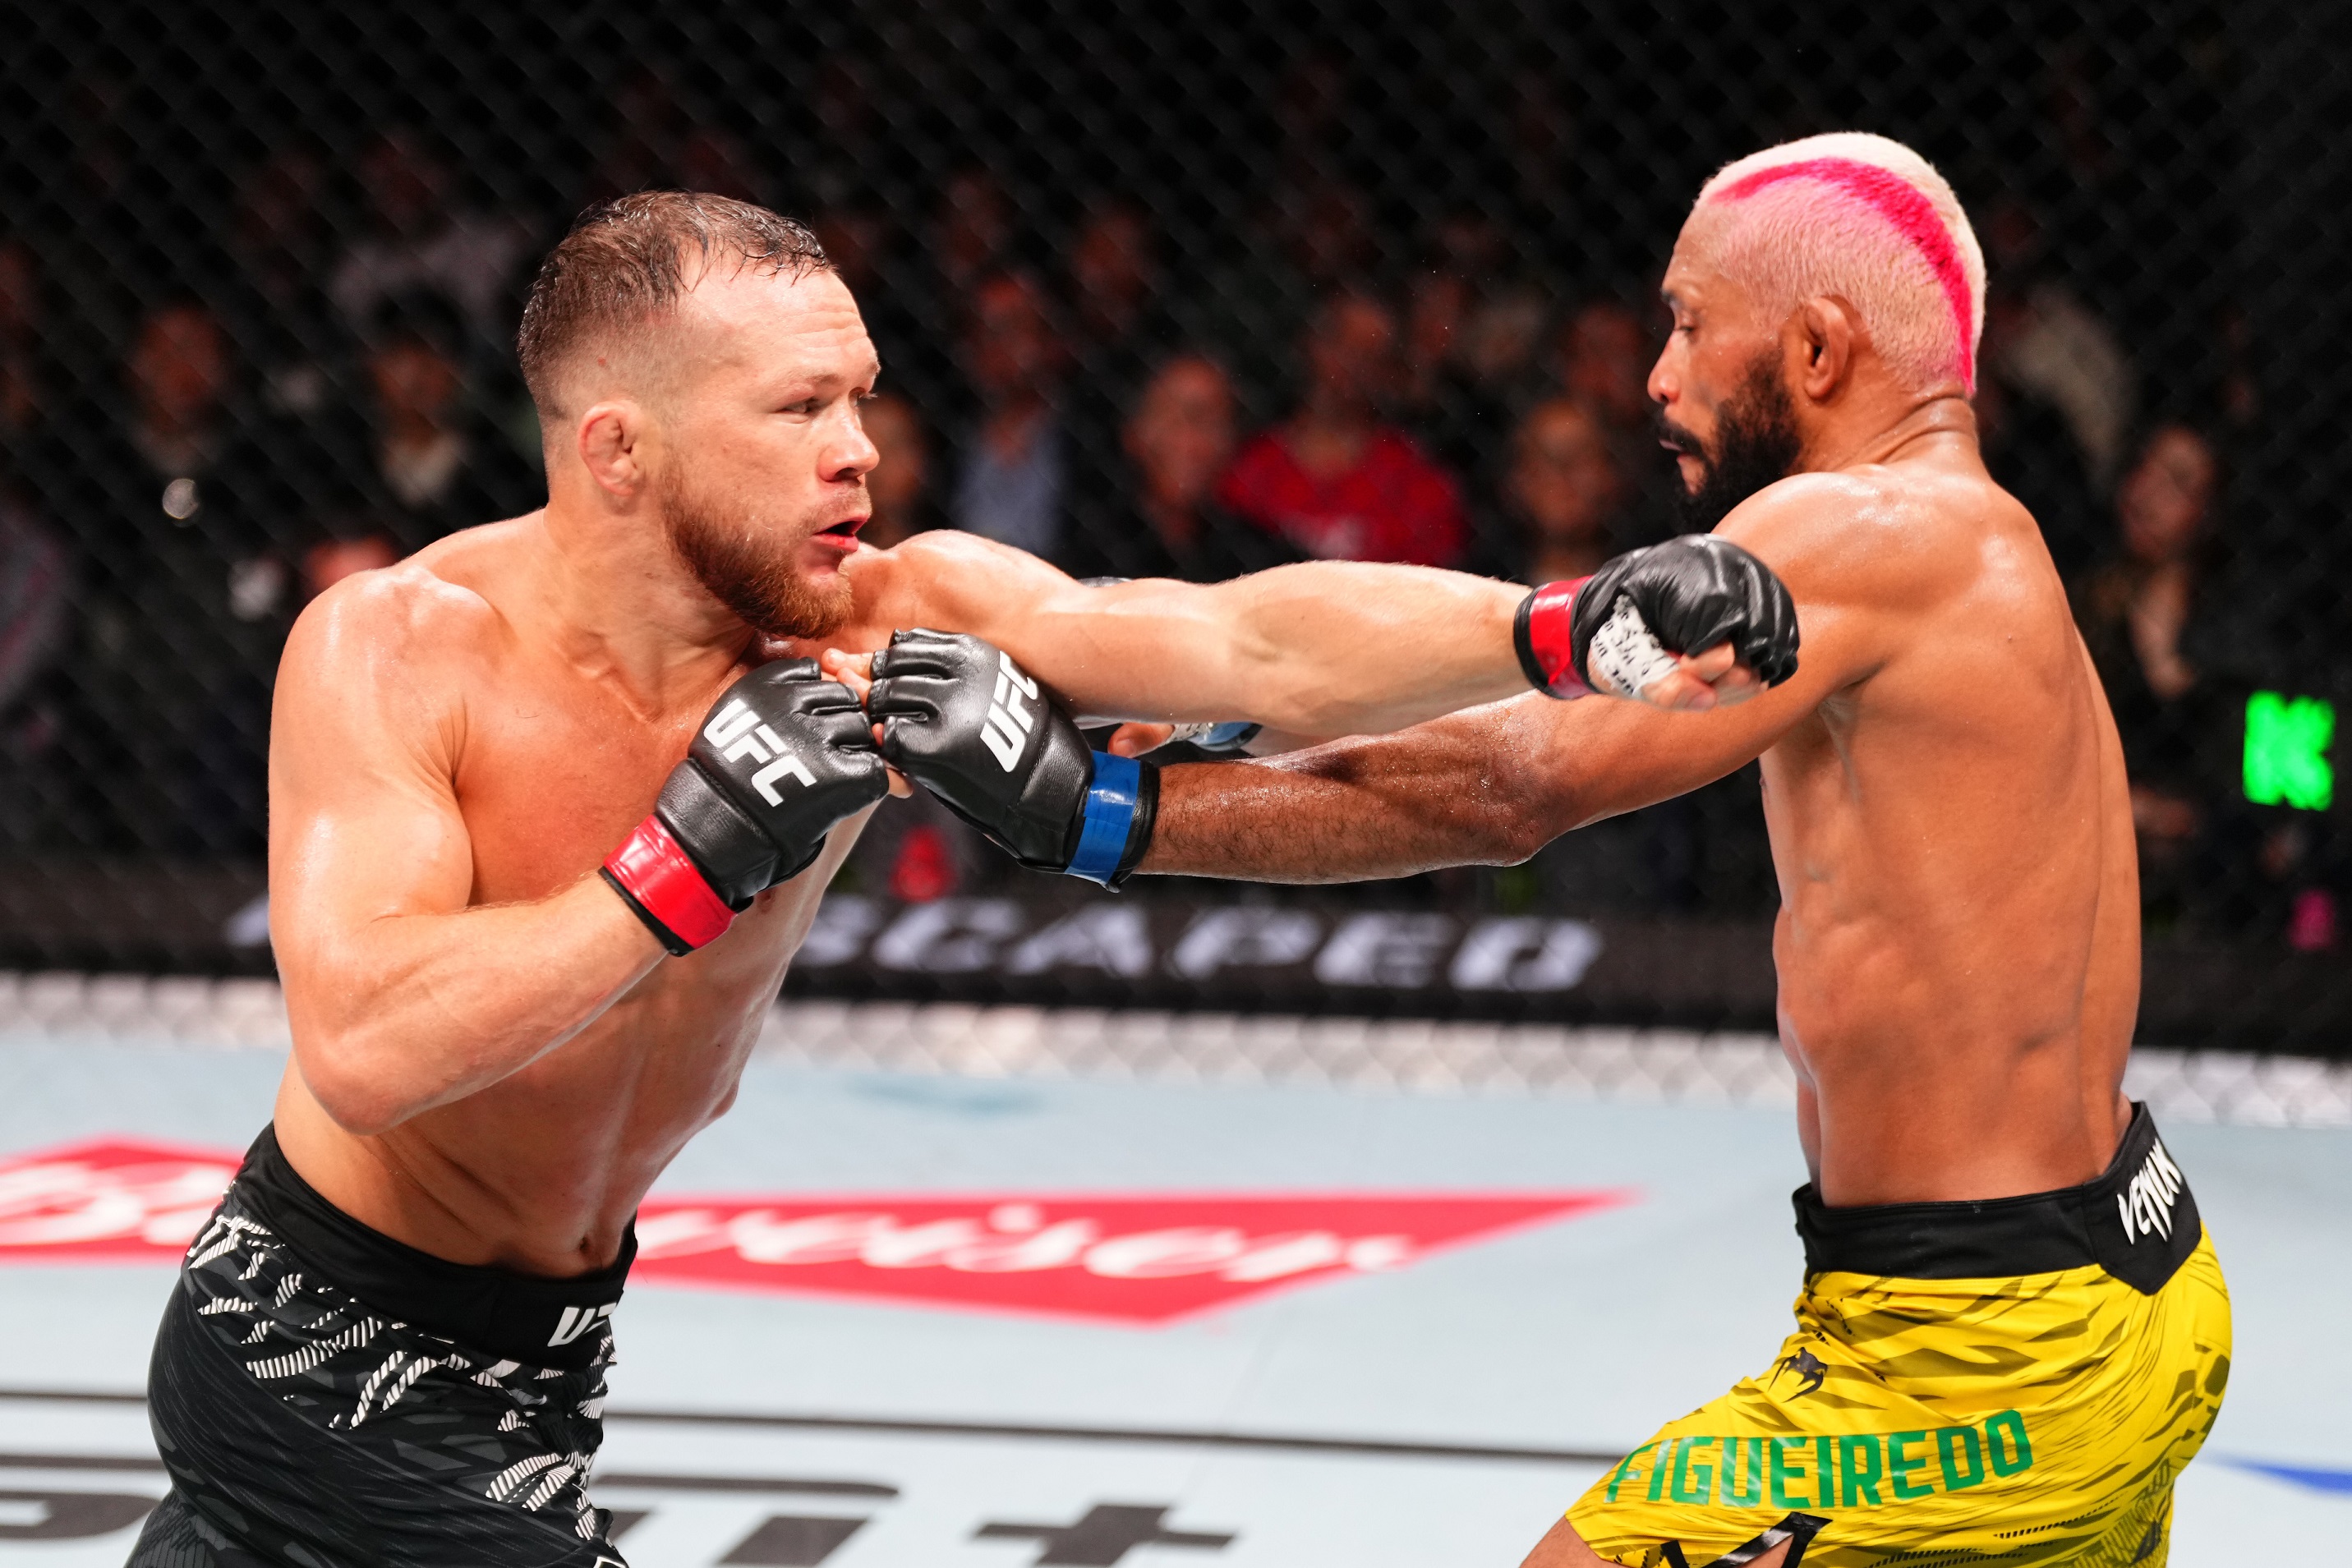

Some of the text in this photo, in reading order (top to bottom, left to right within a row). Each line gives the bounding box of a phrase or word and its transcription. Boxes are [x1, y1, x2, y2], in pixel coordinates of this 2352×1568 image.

[703, 698, 817, 807] UFC
[980, 651, 1038, 773] UFC
[1603, 1409, 2032, 1509] FIGUEIREDO
